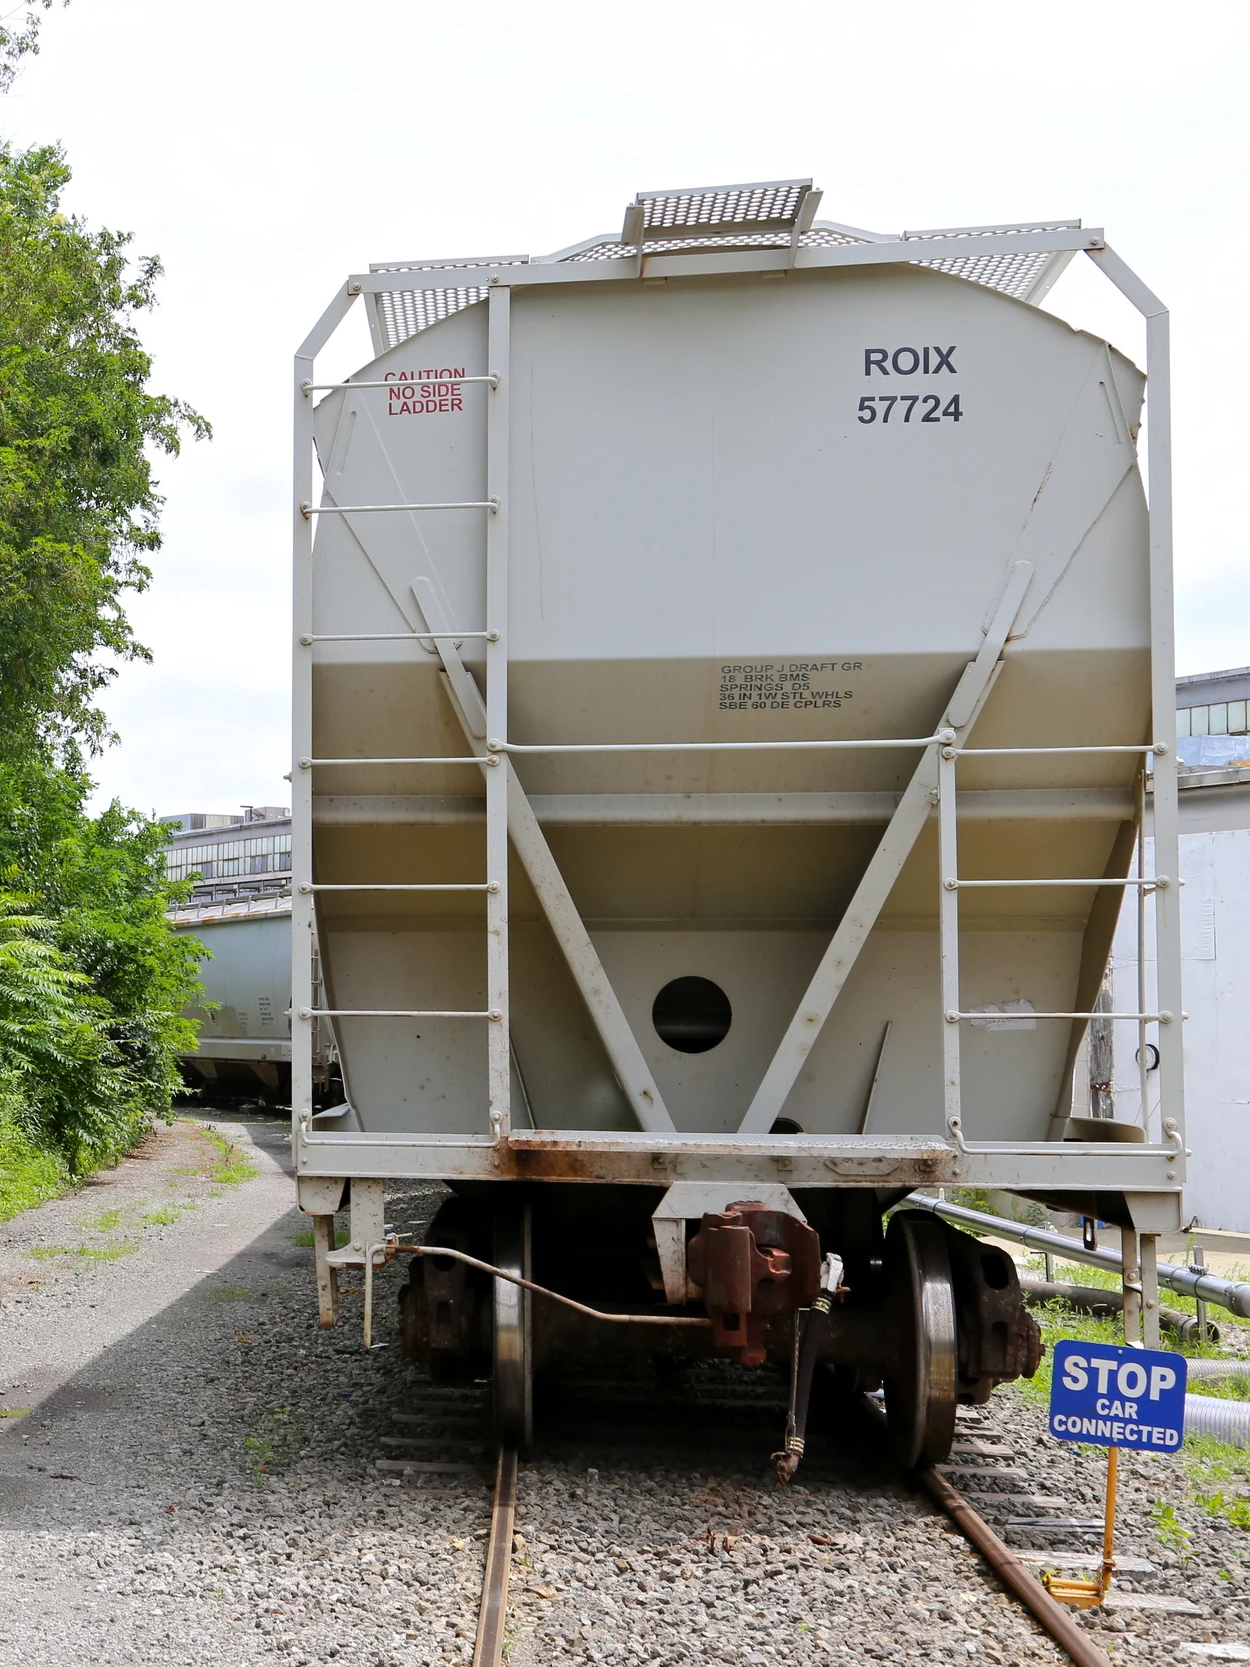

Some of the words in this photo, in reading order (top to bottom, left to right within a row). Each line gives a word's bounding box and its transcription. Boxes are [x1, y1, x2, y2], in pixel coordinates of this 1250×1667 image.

[864, 345, 958, 376] ROIX
[384, 368, 466, 382] CAUTION
[389, 385, 415, 400] NO
[420, 383, 462, 399] SIDE
[389, 398, 463, 416] LADDER
[857, 394, 964, 424] 57724
[721, 664, 774, 674] GROUP
[776, 664, 785, 673] J
[788, 662, 838, 673] DRAFT
[841, 662, 863, 672] GR
[721, 674, 736, 683] 18
[744, 673, 775, 683] BRK
[778, 673, 810, 682] BMS
[719, 682, 784, 692] SPRINGS
[791, 682, 810, 691] D5
[719, 693, 735, 701] 36
[738, 692, 752, 701] IN
[756, 692, 778, 701] 1W
[780, 691, 808, 700] STL
[810, 690, 854, 699] WHLS
[719, 701, 748, 710] SBE
[751, 701, 767, 710] 60
[770, 700, 790, 709] DE
[793, 699, 842, 709] CPLRS
[1062, 1355, 1177, 1401] STOP
[1096, 1398, 1138, 1420] CAR
[1053, 1414, 1179, 1446] CONNECTED
